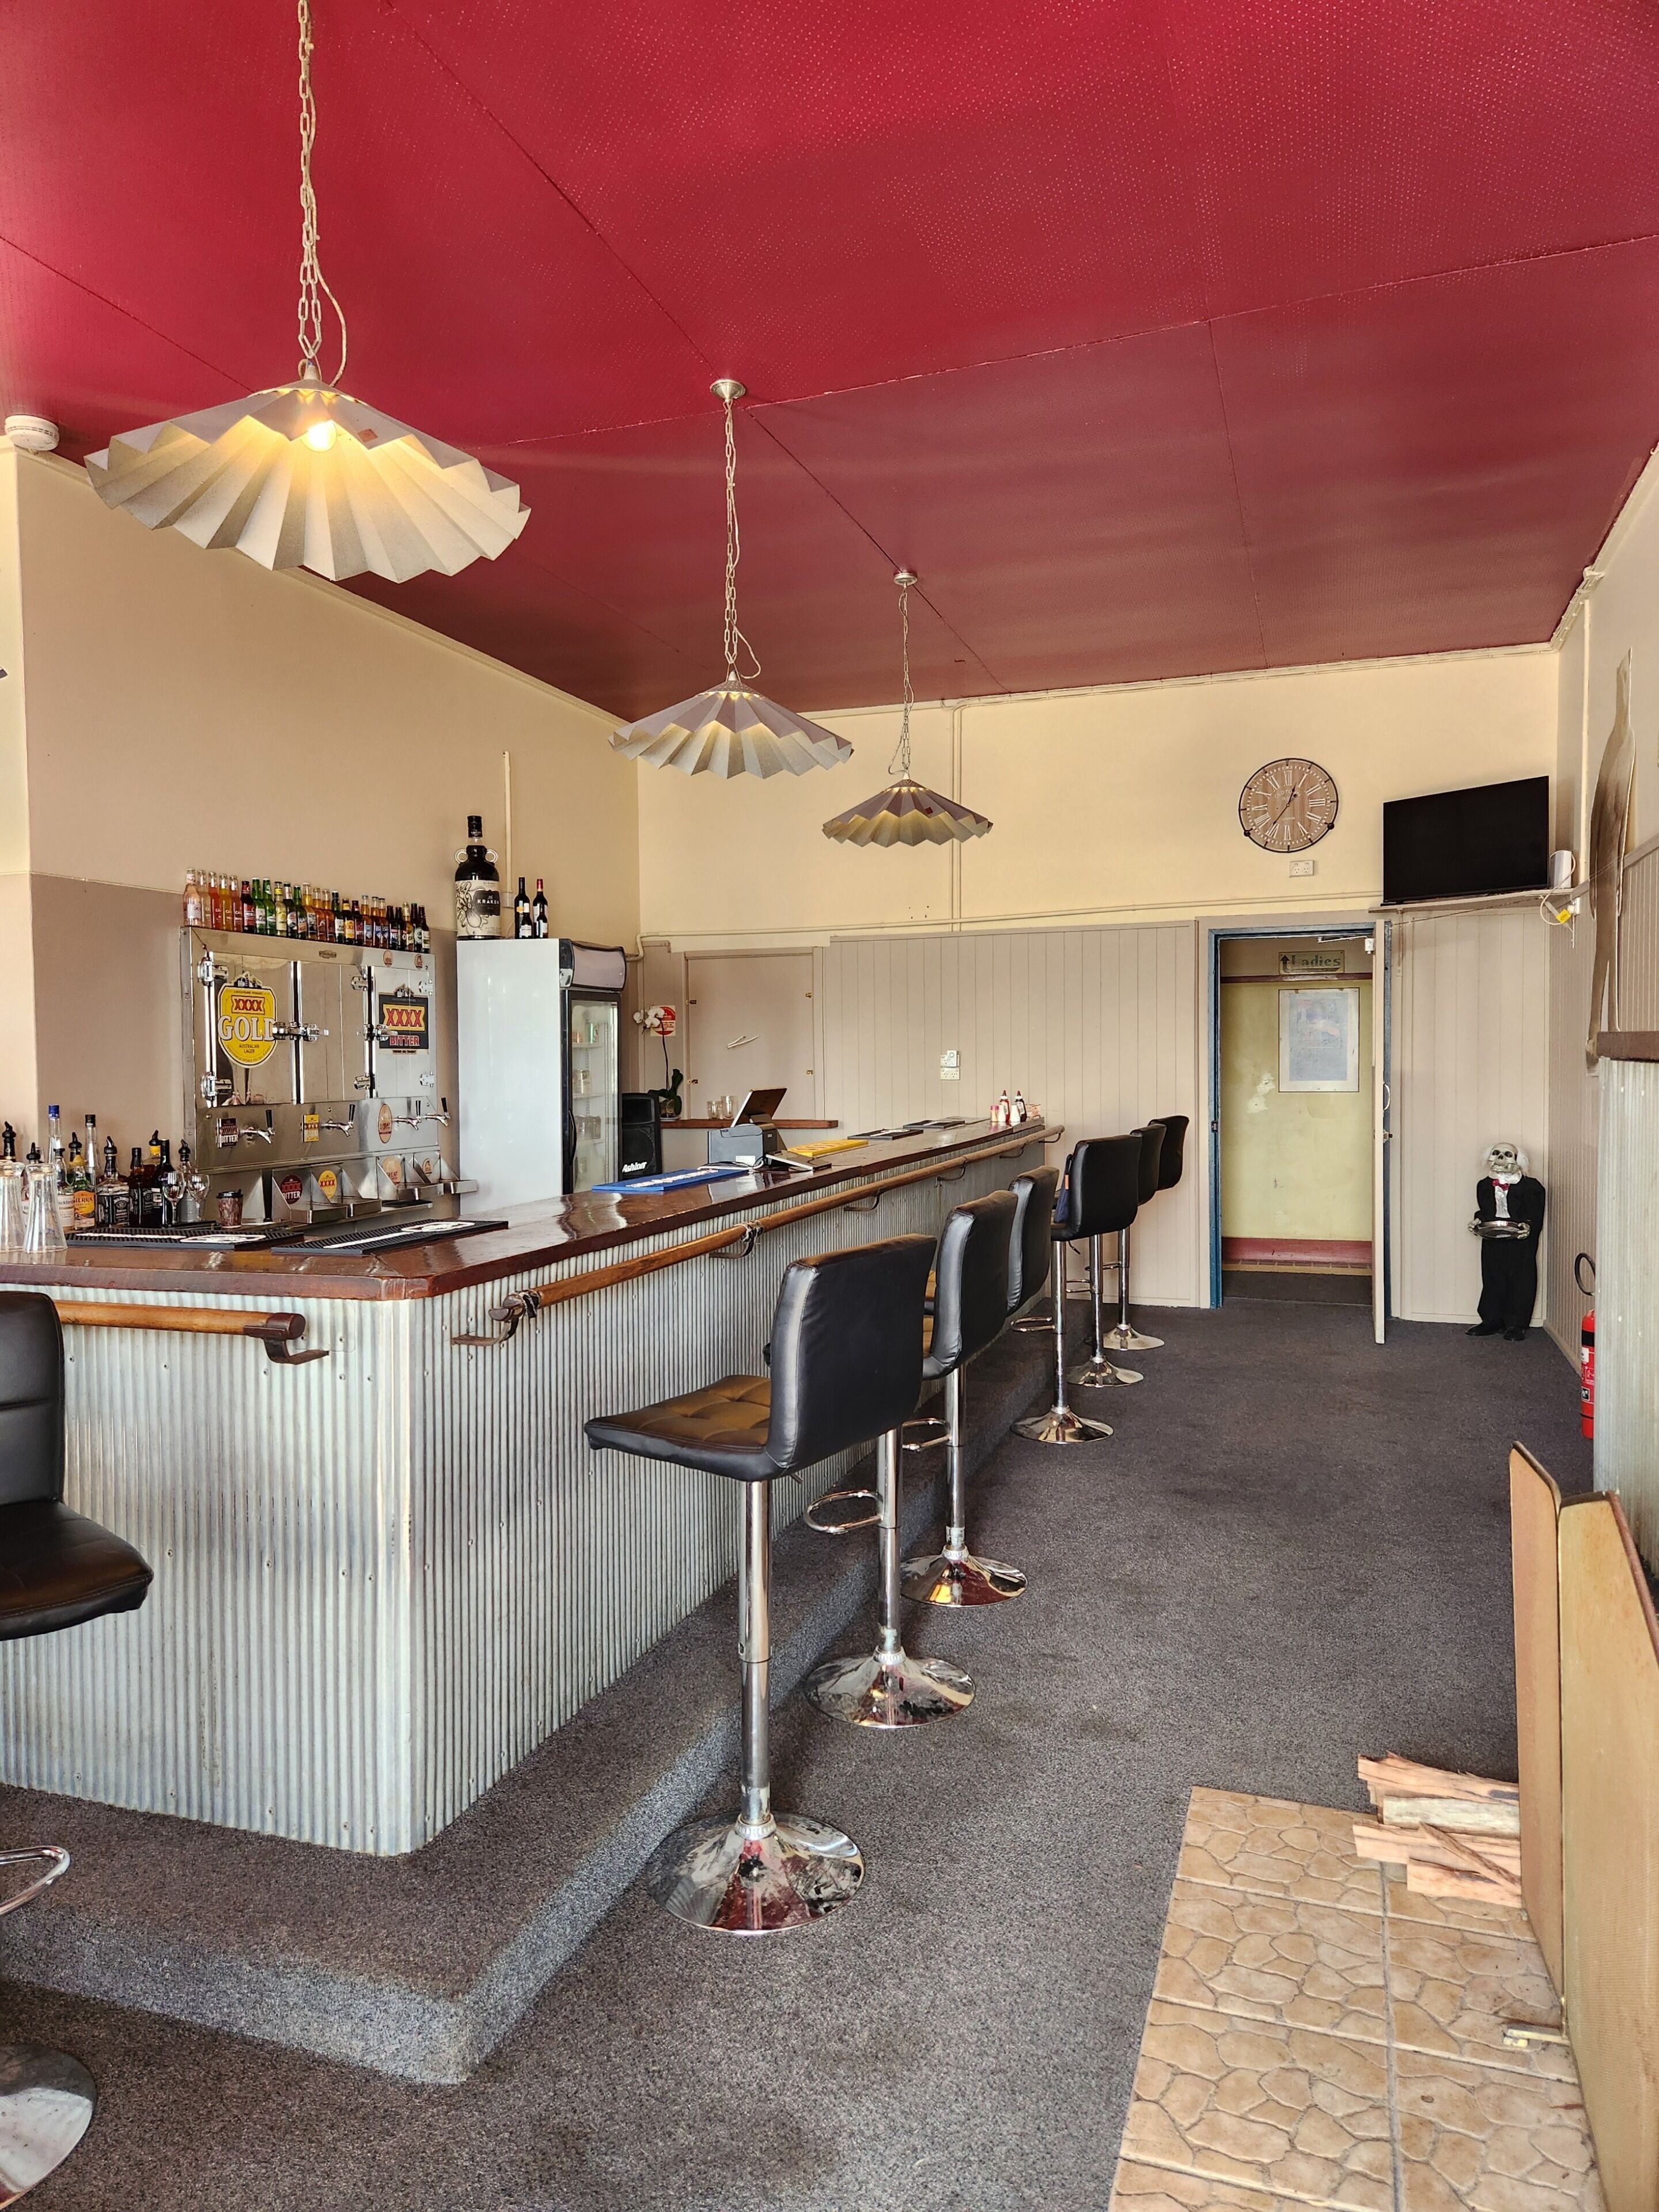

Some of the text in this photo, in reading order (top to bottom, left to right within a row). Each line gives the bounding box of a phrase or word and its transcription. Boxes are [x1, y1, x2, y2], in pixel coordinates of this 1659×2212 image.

[1291, 955, 1341, 967] Ladies
[234, 998, 263, 1012] XXXX
[385, 1008, 423, 1028] XXXX
[217, 1015, 276, 1041] GOLD
[389, 1035, 421, 1047] BITTER
[220, 1135, 238, 1143] BITTER
